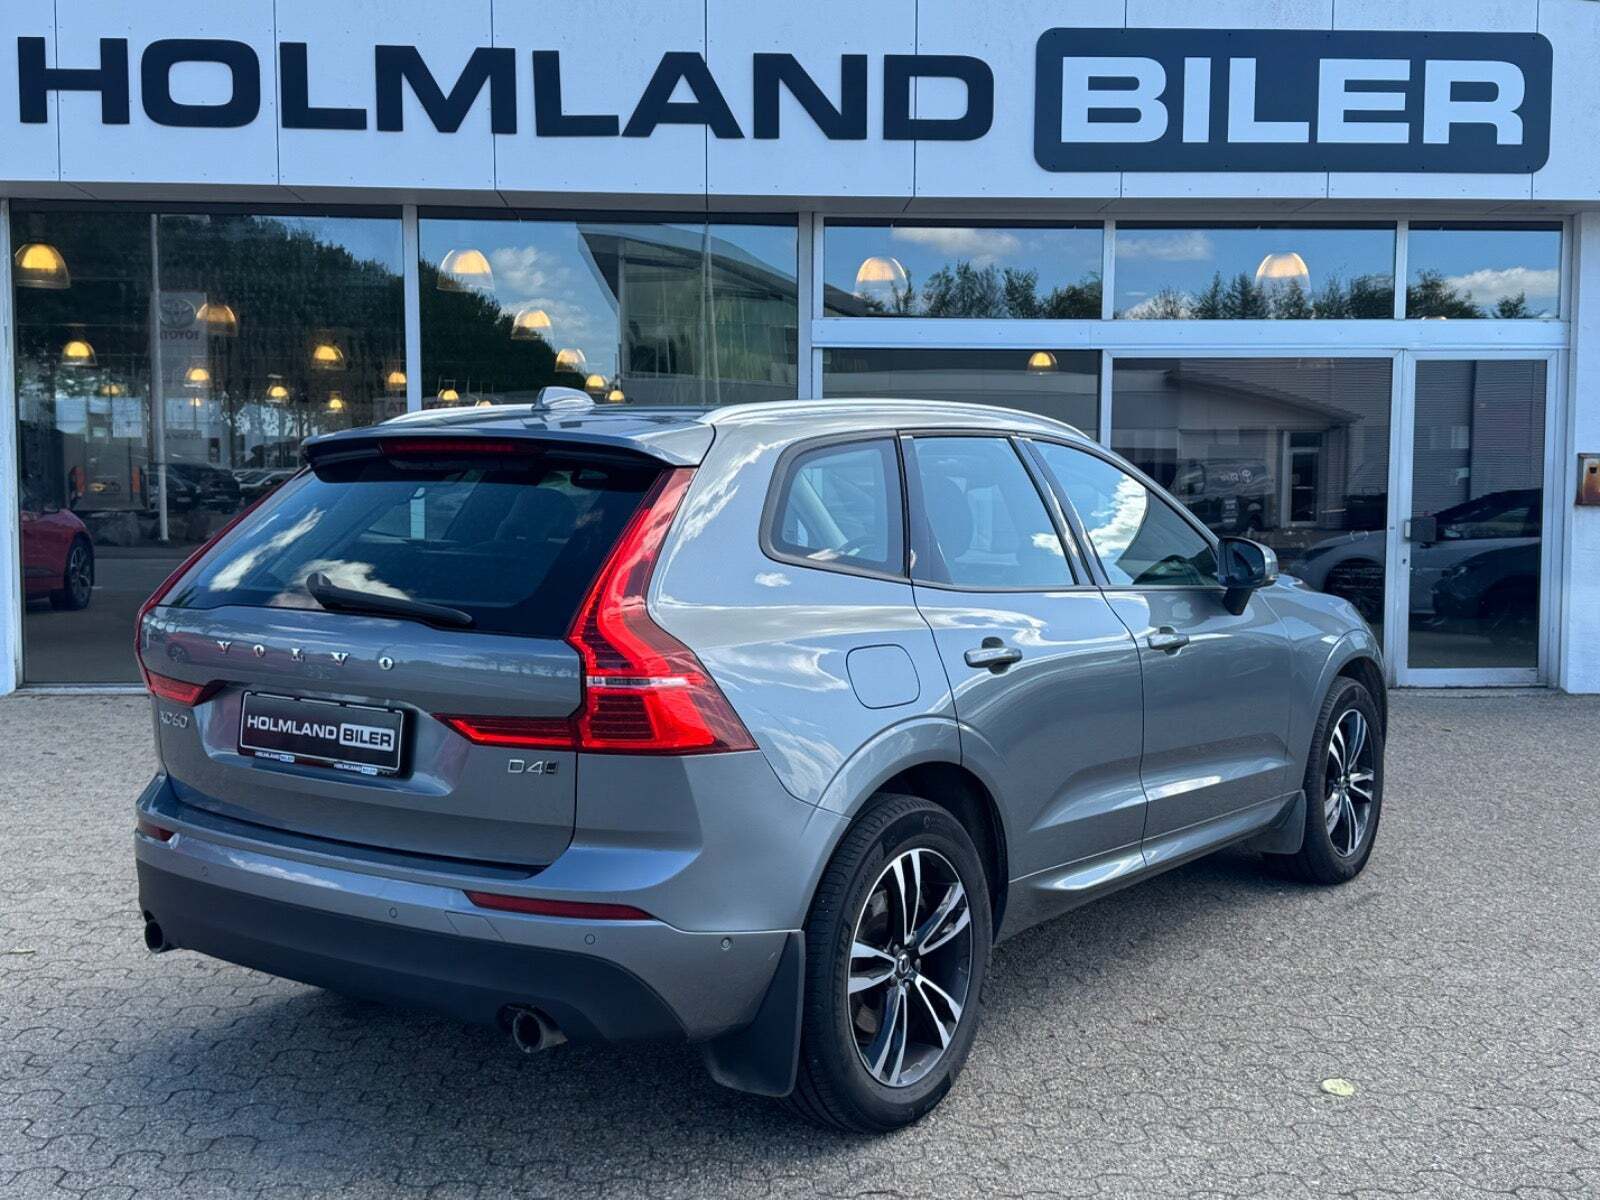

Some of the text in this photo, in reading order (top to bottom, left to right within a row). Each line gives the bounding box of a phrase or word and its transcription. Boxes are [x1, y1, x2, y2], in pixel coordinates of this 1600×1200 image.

[17, 36, 1526, 146] HOLMLAND BILER
[217, 640, 394, 671] VOLVO
[247, 714, 393, 747] HOLMLAND BILER
[507, 759, 544, 775] D4
